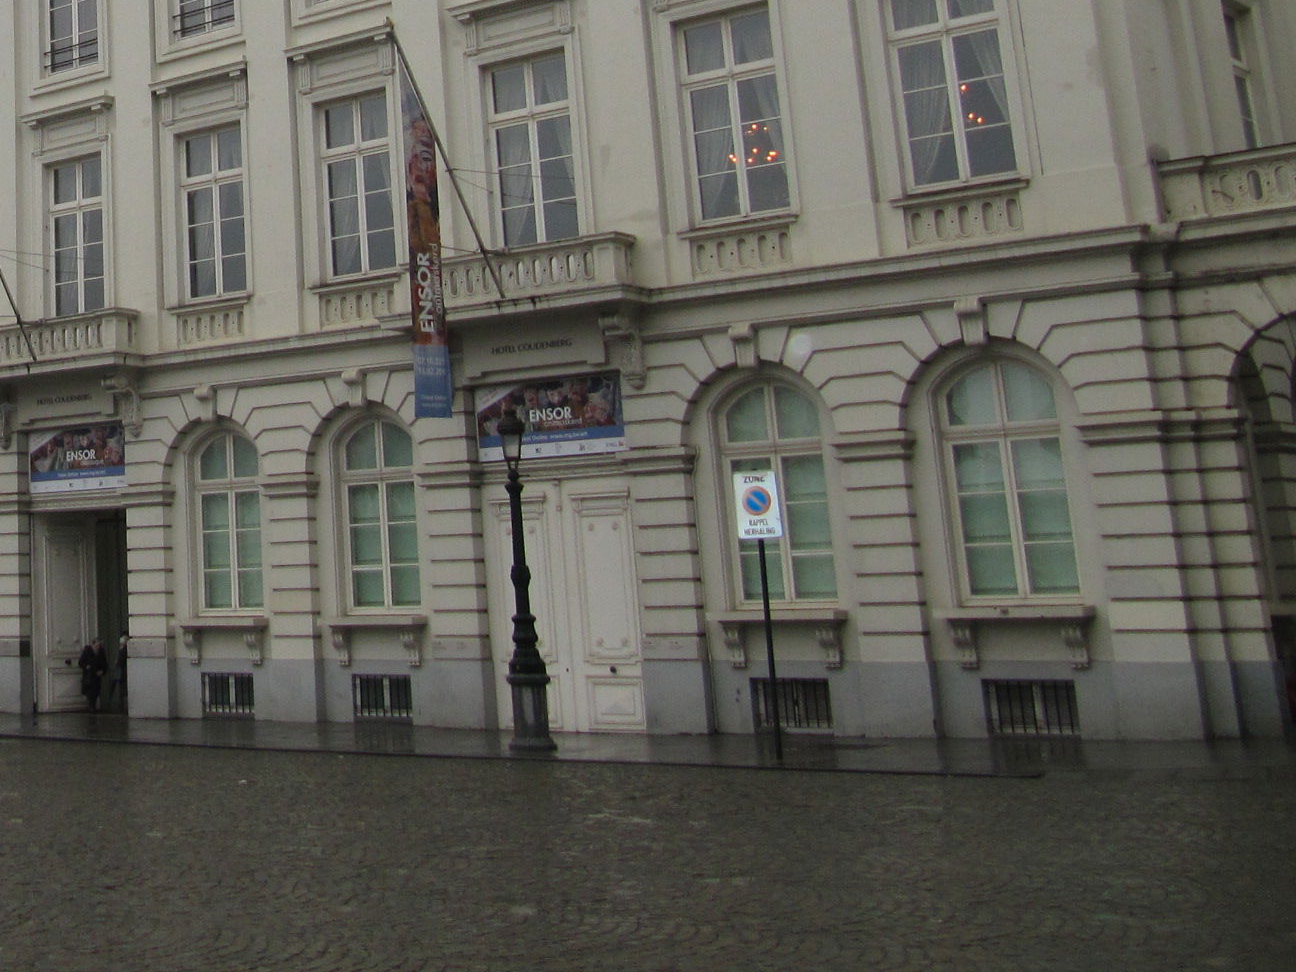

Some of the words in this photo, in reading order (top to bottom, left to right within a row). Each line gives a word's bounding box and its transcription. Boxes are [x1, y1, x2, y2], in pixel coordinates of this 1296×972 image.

[417, 251, 434, 333] ENSOR
[529, 406, 572, 422] ENSOR
[66, 449, 96, 461] ENSOR
